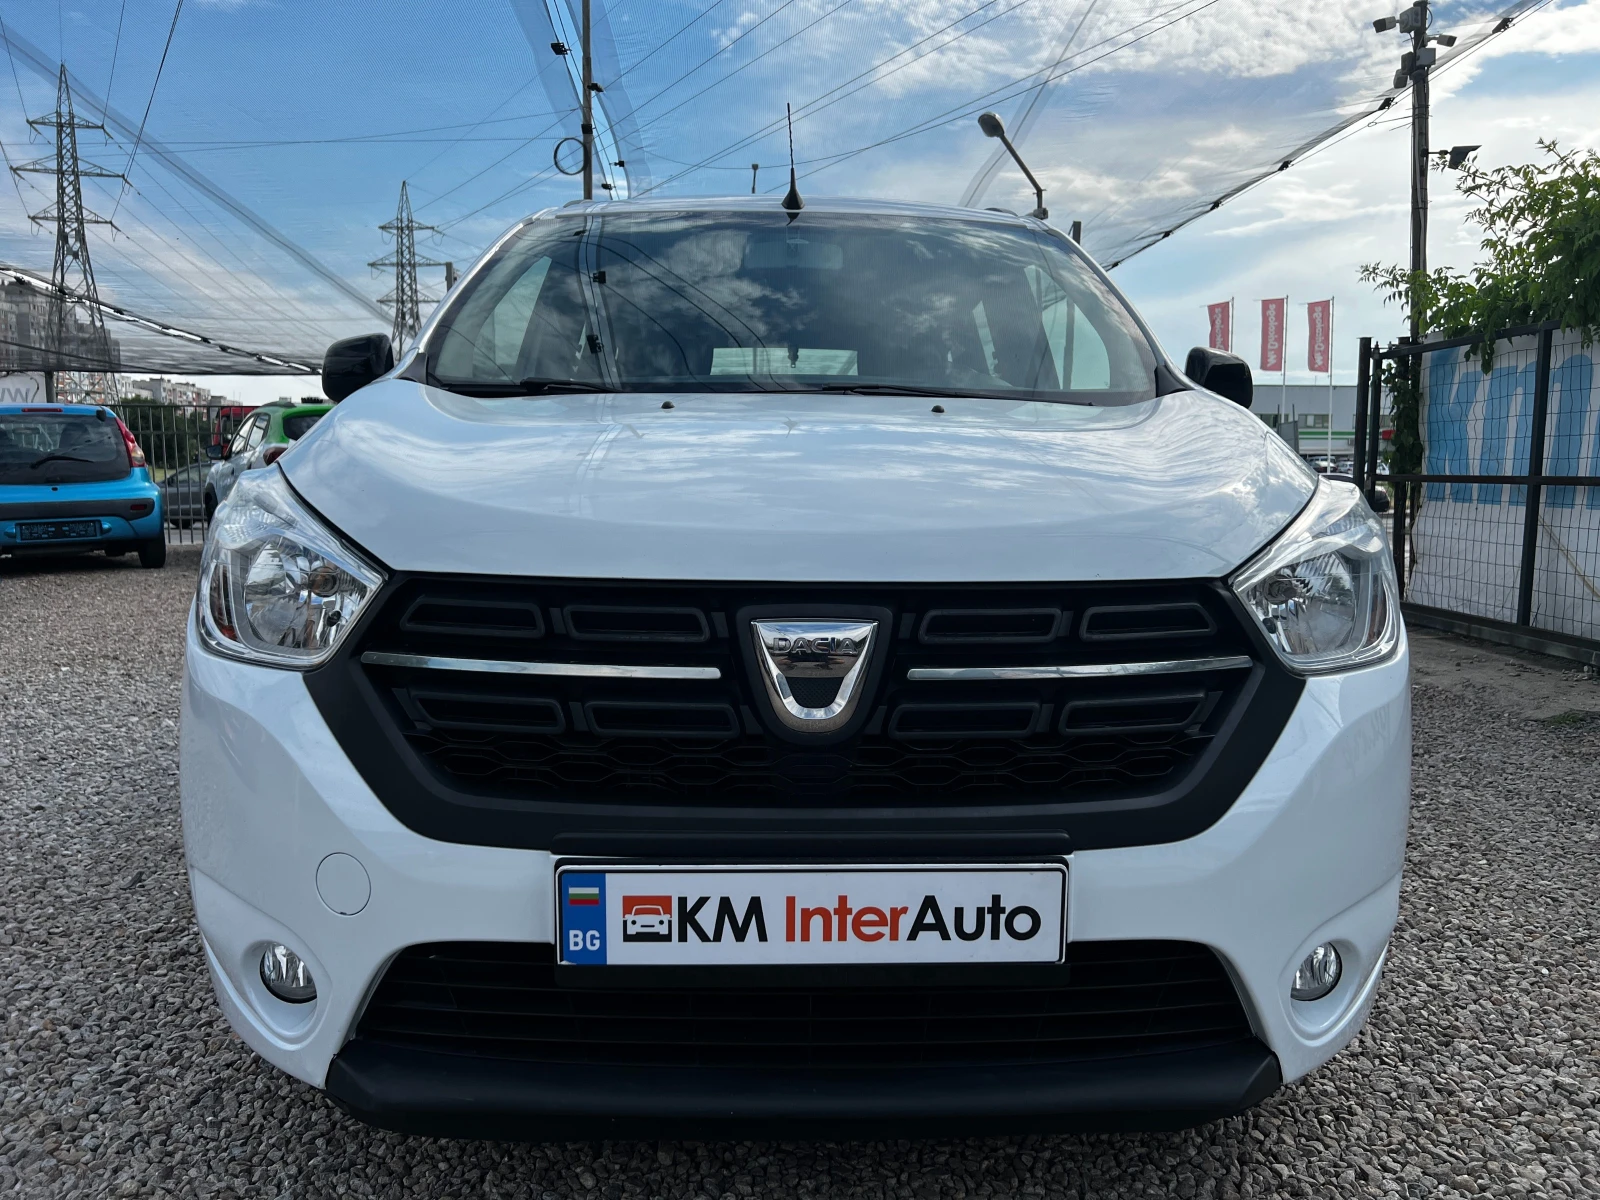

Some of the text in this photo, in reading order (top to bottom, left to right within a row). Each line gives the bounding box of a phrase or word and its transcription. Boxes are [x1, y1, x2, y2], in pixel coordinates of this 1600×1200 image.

[773, 636, 858, 654] DACIA
[677, 894, 1042, 943] KM InterAuto
[568, 929, 601, 951] BG
